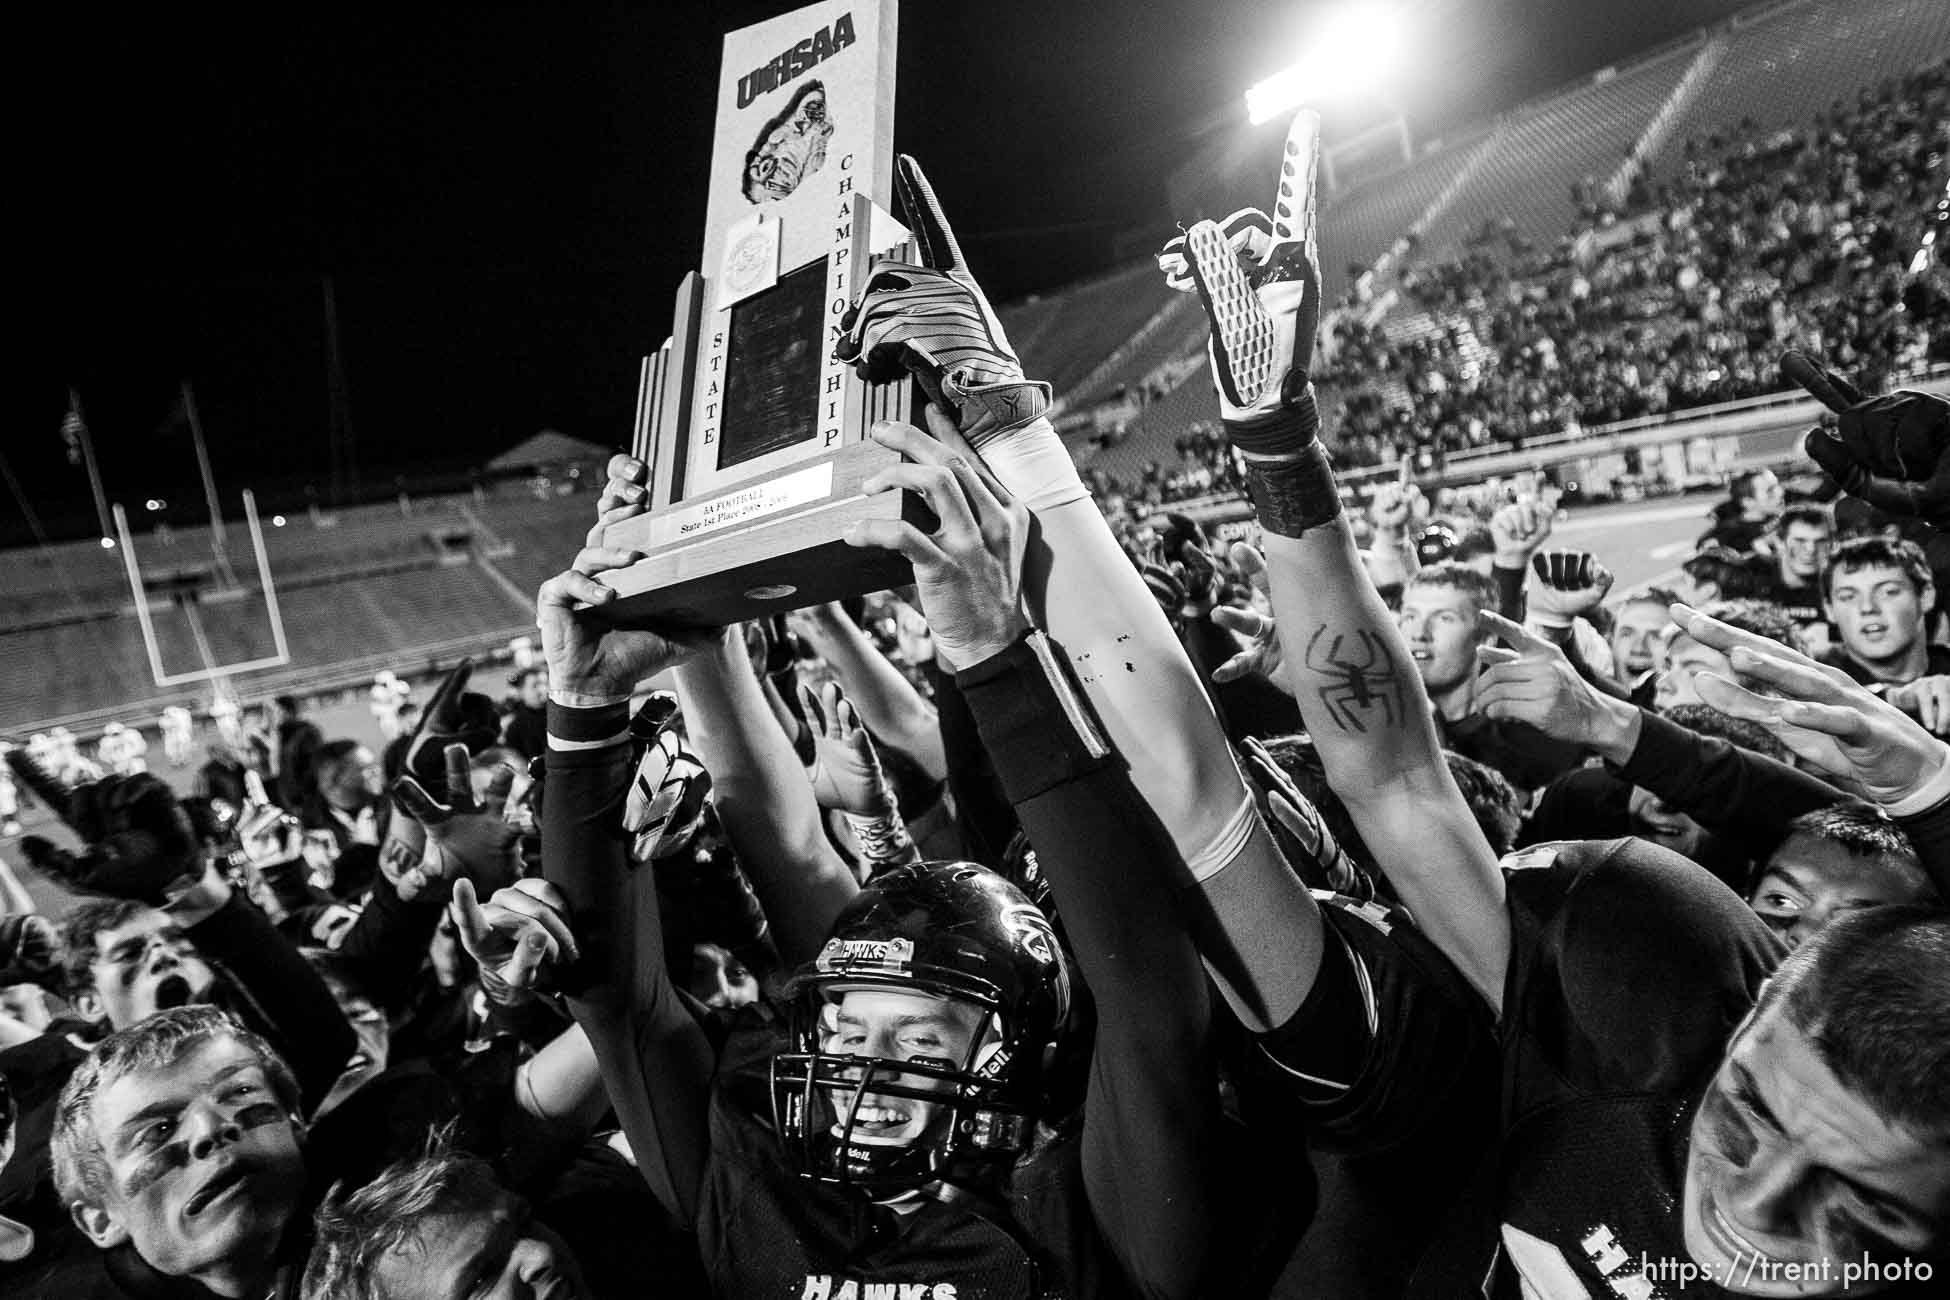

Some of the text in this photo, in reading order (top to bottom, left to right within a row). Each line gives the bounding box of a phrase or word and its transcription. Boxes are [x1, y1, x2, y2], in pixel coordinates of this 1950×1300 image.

[824, 152, 853, 448] CHAMPIONSHIP
[703, 332, 723, 445] STATE
[716, 489, 763, 511] FOOTBALL
[681, 521, 702, 534] State
[704, 516, 716, 527] 1st
[717, 509, 741, 523] Place
[841, 942, 888, 959] HAWKS
[801, 1274, 957, 1300] HAWKS
